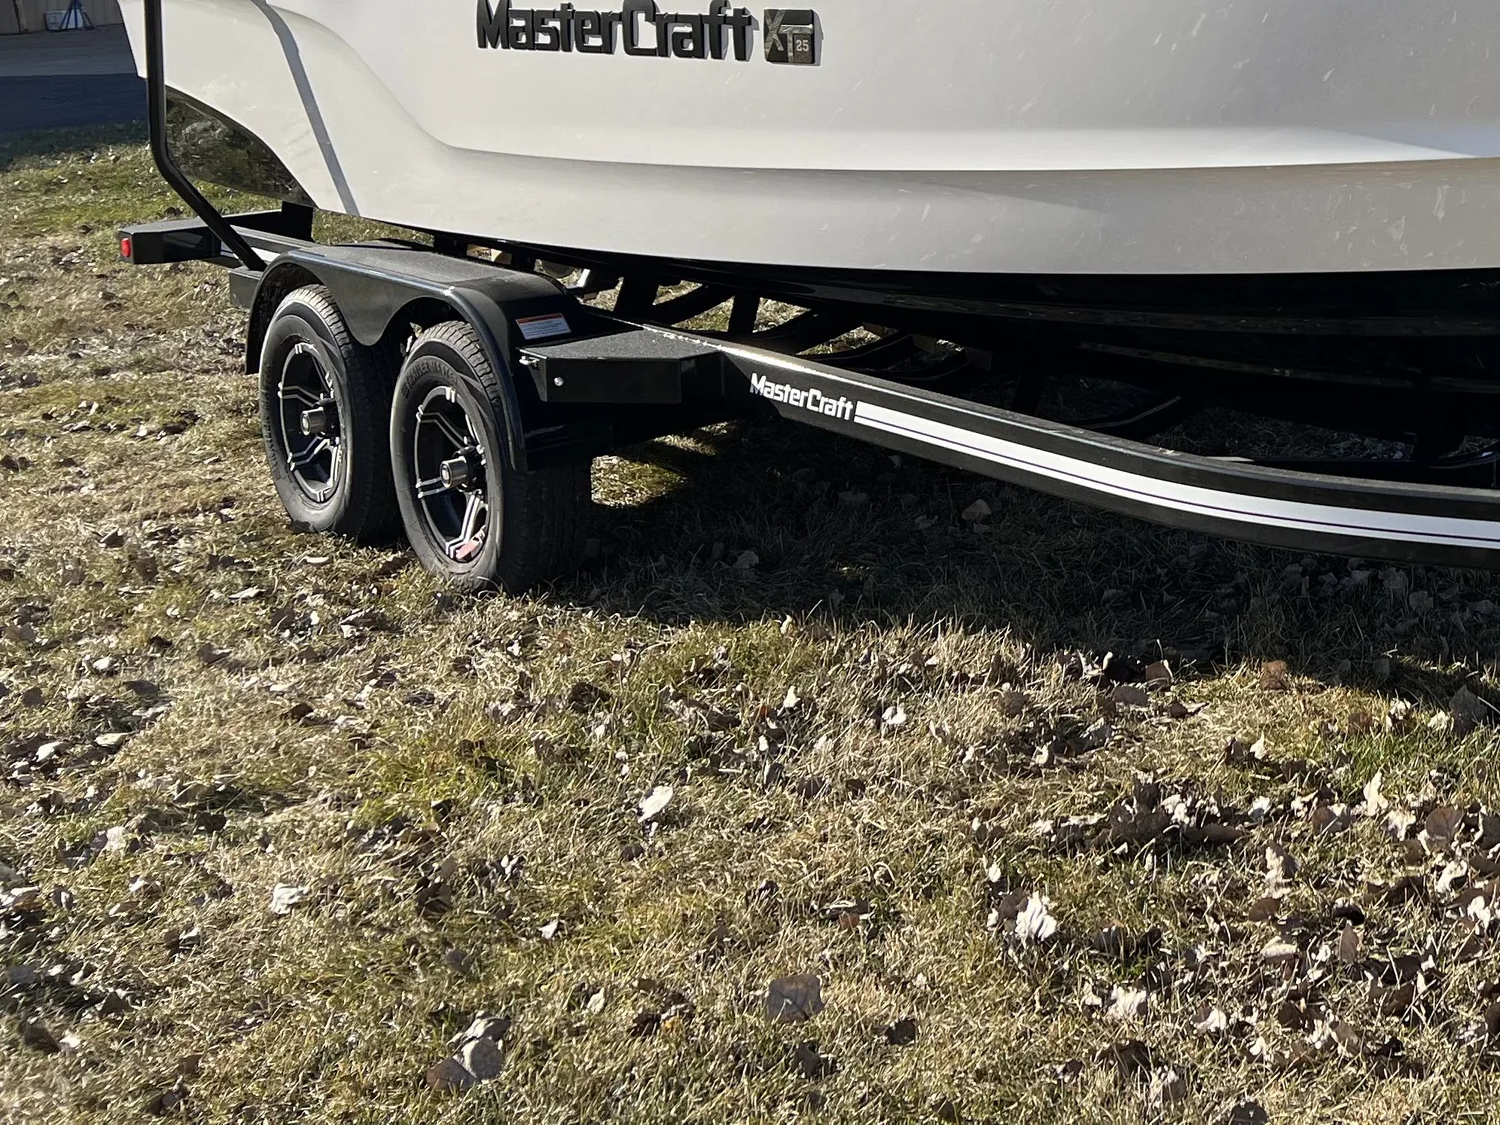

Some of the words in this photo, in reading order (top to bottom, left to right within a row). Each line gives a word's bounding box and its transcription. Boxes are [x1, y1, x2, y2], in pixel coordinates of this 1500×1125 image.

[764, 9, 814, 63] XT
[796, 39, 809, 52] 25
[750, 372, 853, 421] MasterCraft
